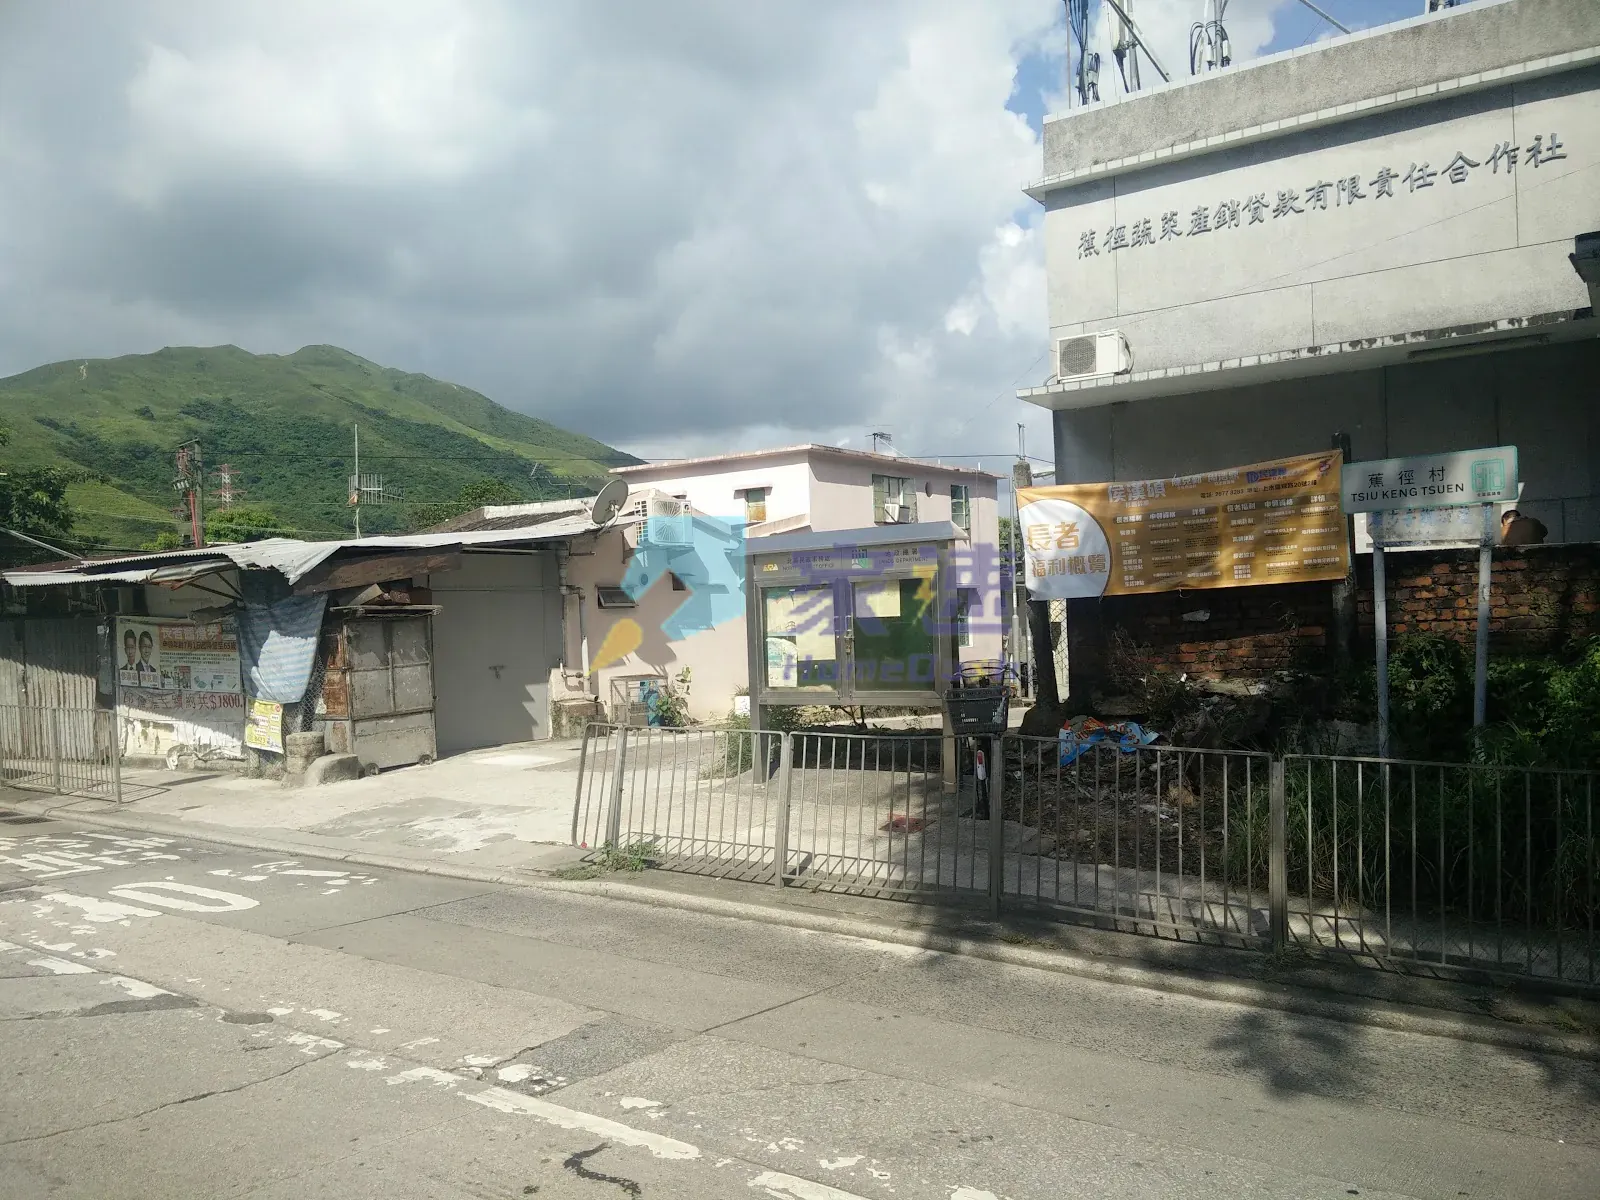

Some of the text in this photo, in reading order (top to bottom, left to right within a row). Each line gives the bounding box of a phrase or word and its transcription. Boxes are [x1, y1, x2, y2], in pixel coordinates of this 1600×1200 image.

[1368, 466, 1445, 489] 蕉徑村
[1351, 483, 1465, 502] TSIU KENG TSUEN
[1026, 520, 1080, 551] 長者
[1031, 552, 1107, 577] 福利概覽
